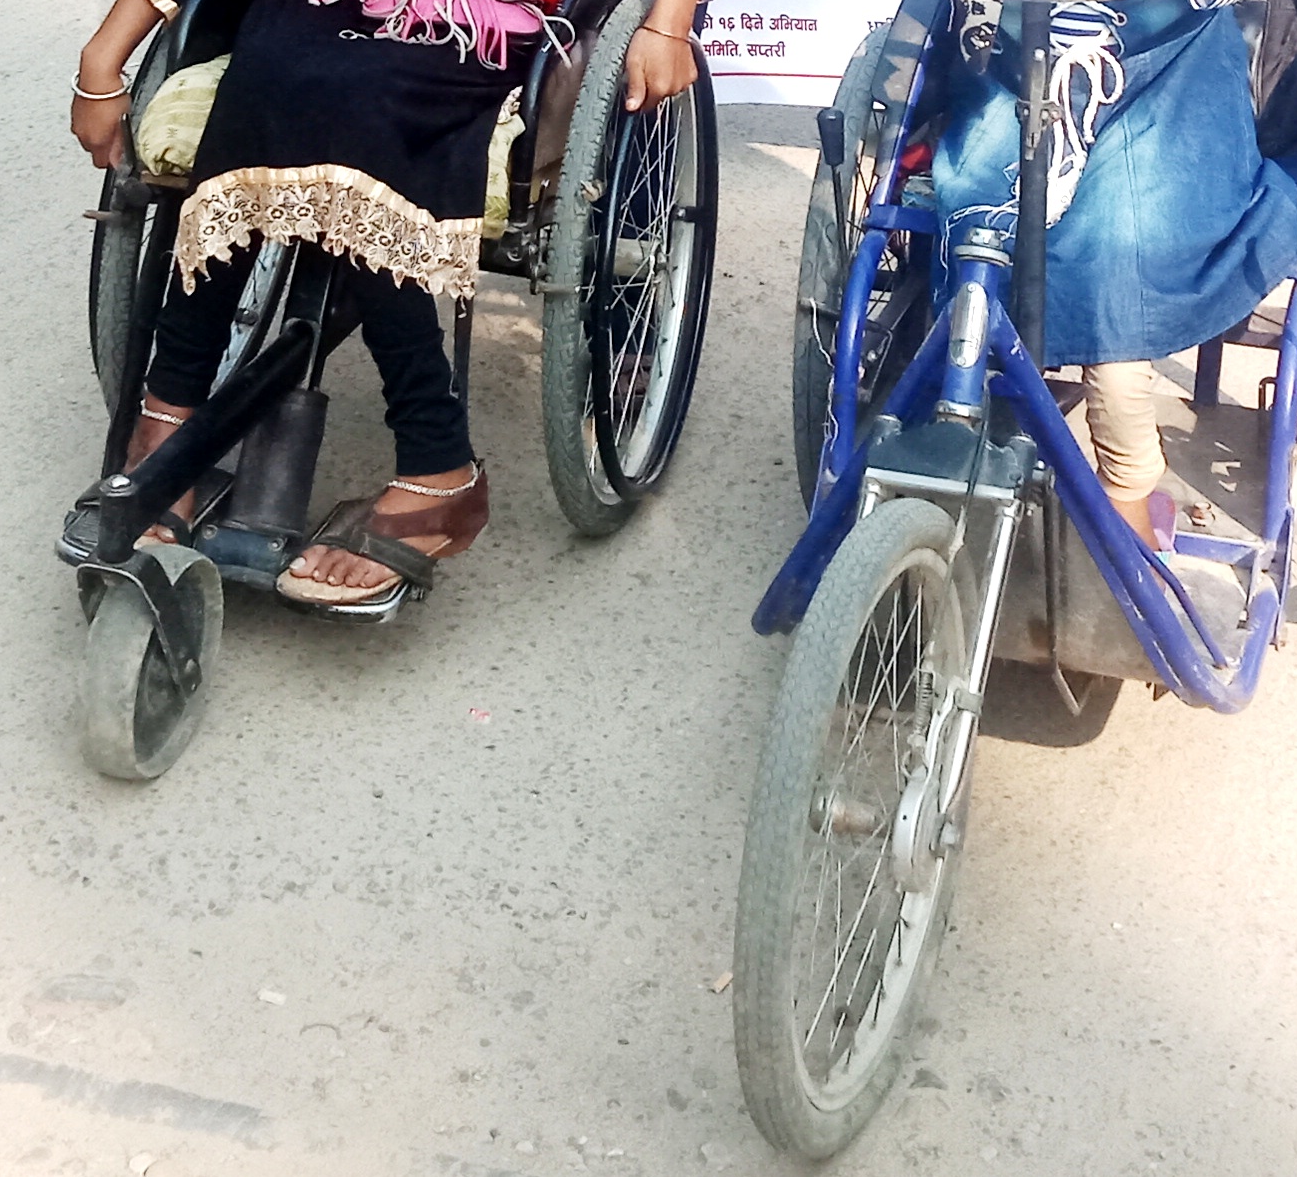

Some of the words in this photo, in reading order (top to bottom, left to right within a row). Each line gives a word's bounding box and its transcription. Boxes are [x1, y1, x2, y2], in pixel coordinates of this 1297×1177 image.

[719, 17, 736, 32] १६
[740, 12, 764, 32] दिने
[768, 13, 818, 32] अभियान
[746, 40, 786, 58] सप्तरी
